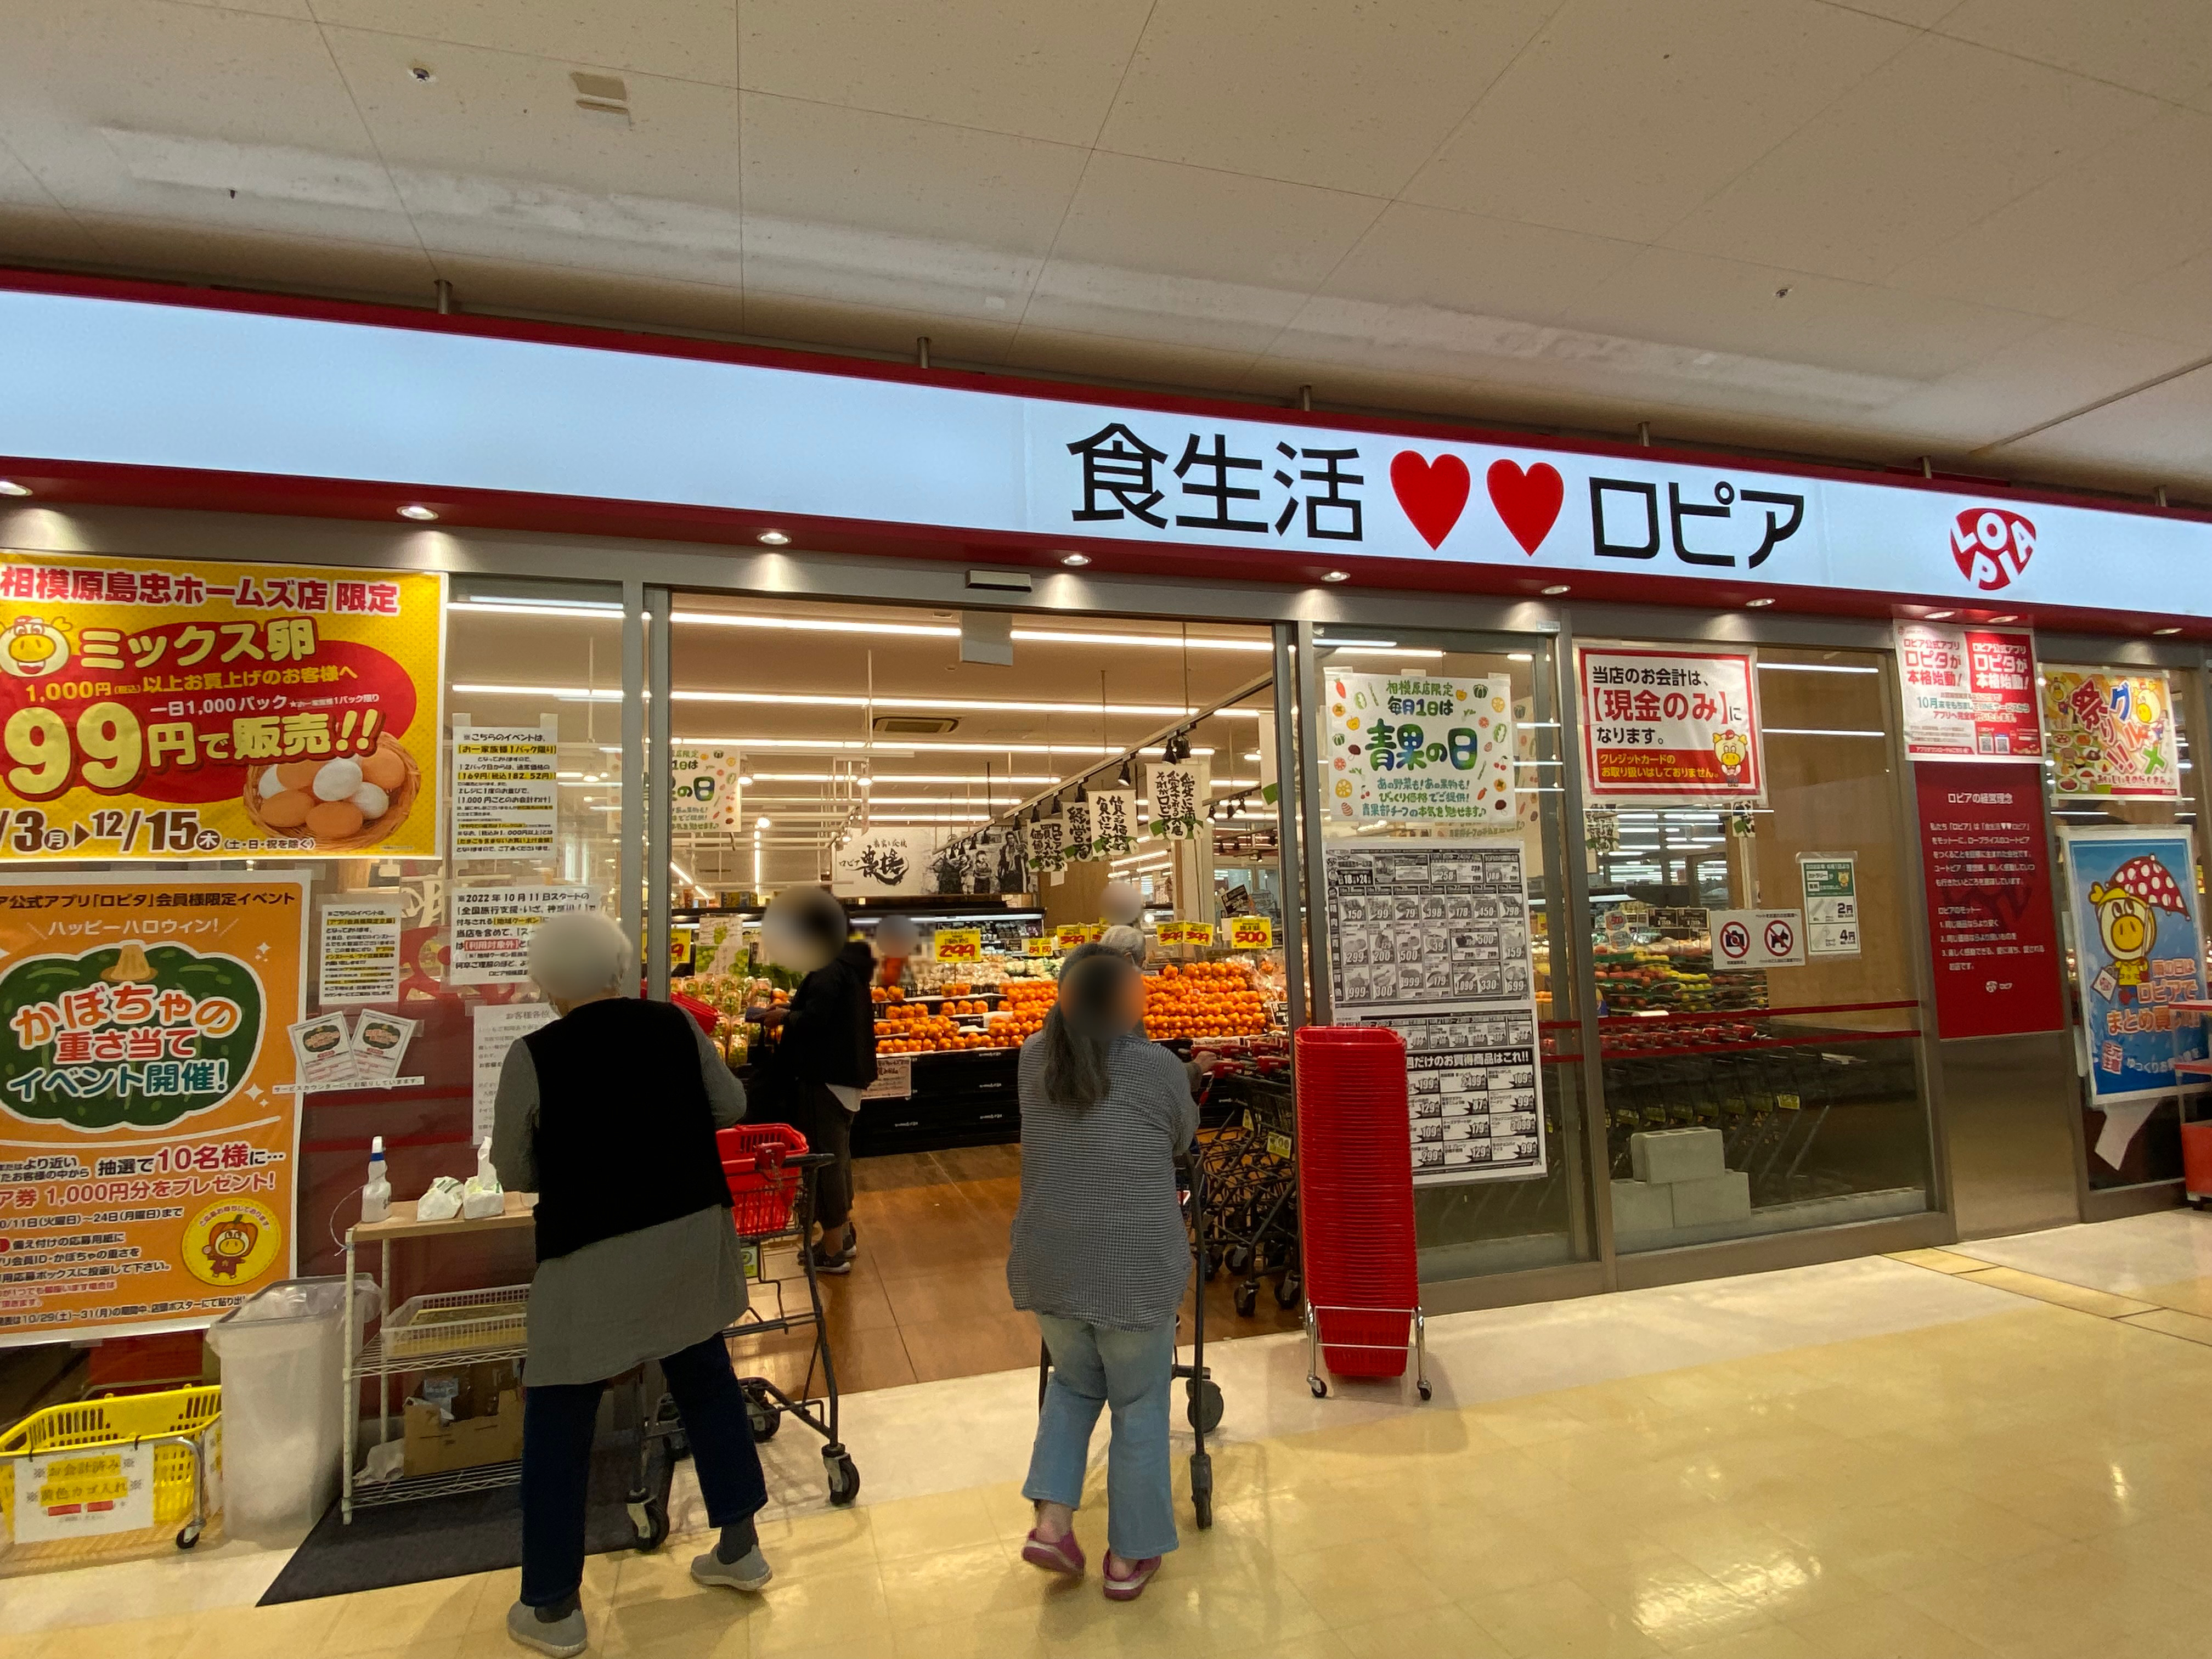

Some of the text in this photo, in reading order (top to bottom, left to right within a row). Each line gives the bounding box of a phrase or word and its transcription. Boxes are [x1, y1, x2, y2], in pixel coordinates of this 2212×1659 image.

[1066, 423, 1804, 569] 食生活 ロピア
[0, 567, 398, 614] 相模原島忠ホームズ店 限定
[81, 619, 317, 670] ミックス卵
[1904, 639, 1960, 650] ロピア公式アプリ
[1905, 650, 1962, 669] ロピタが
[1973, 653, 2028, 674] ロピタが
[1592, 665, 1709, 687] 当店のお会計は、
[1907, 669, 1962, 687] 本格始動!
[1976, 673, 2030, 690] 本格始動!
[1387, 680, 1454, 697] 相模原店限定
[1387, 696, 1454, 716] 毎月1日は
[1365, 718, 1479, 771] 青果の日
[1596, 727, 1663, 745] なります。
[1600, 754, 1676, 765] クレジットカードの
[1601, 767, 1719, 779] お取り扱いはしておりません。
[1948, 793, 2014, 805] ロピアの経営理念
[48, 918, 219, 936] ハッピーハロウィン!
[15, 984, 238, 1046] かぼちゃの
[55, 1029, 198, 1062] 重さ当て
[10, 1061, 228, 1101] イベント開催!
[0, 1262, 170, 1283] 用応募ボックスに投函して下さい。
